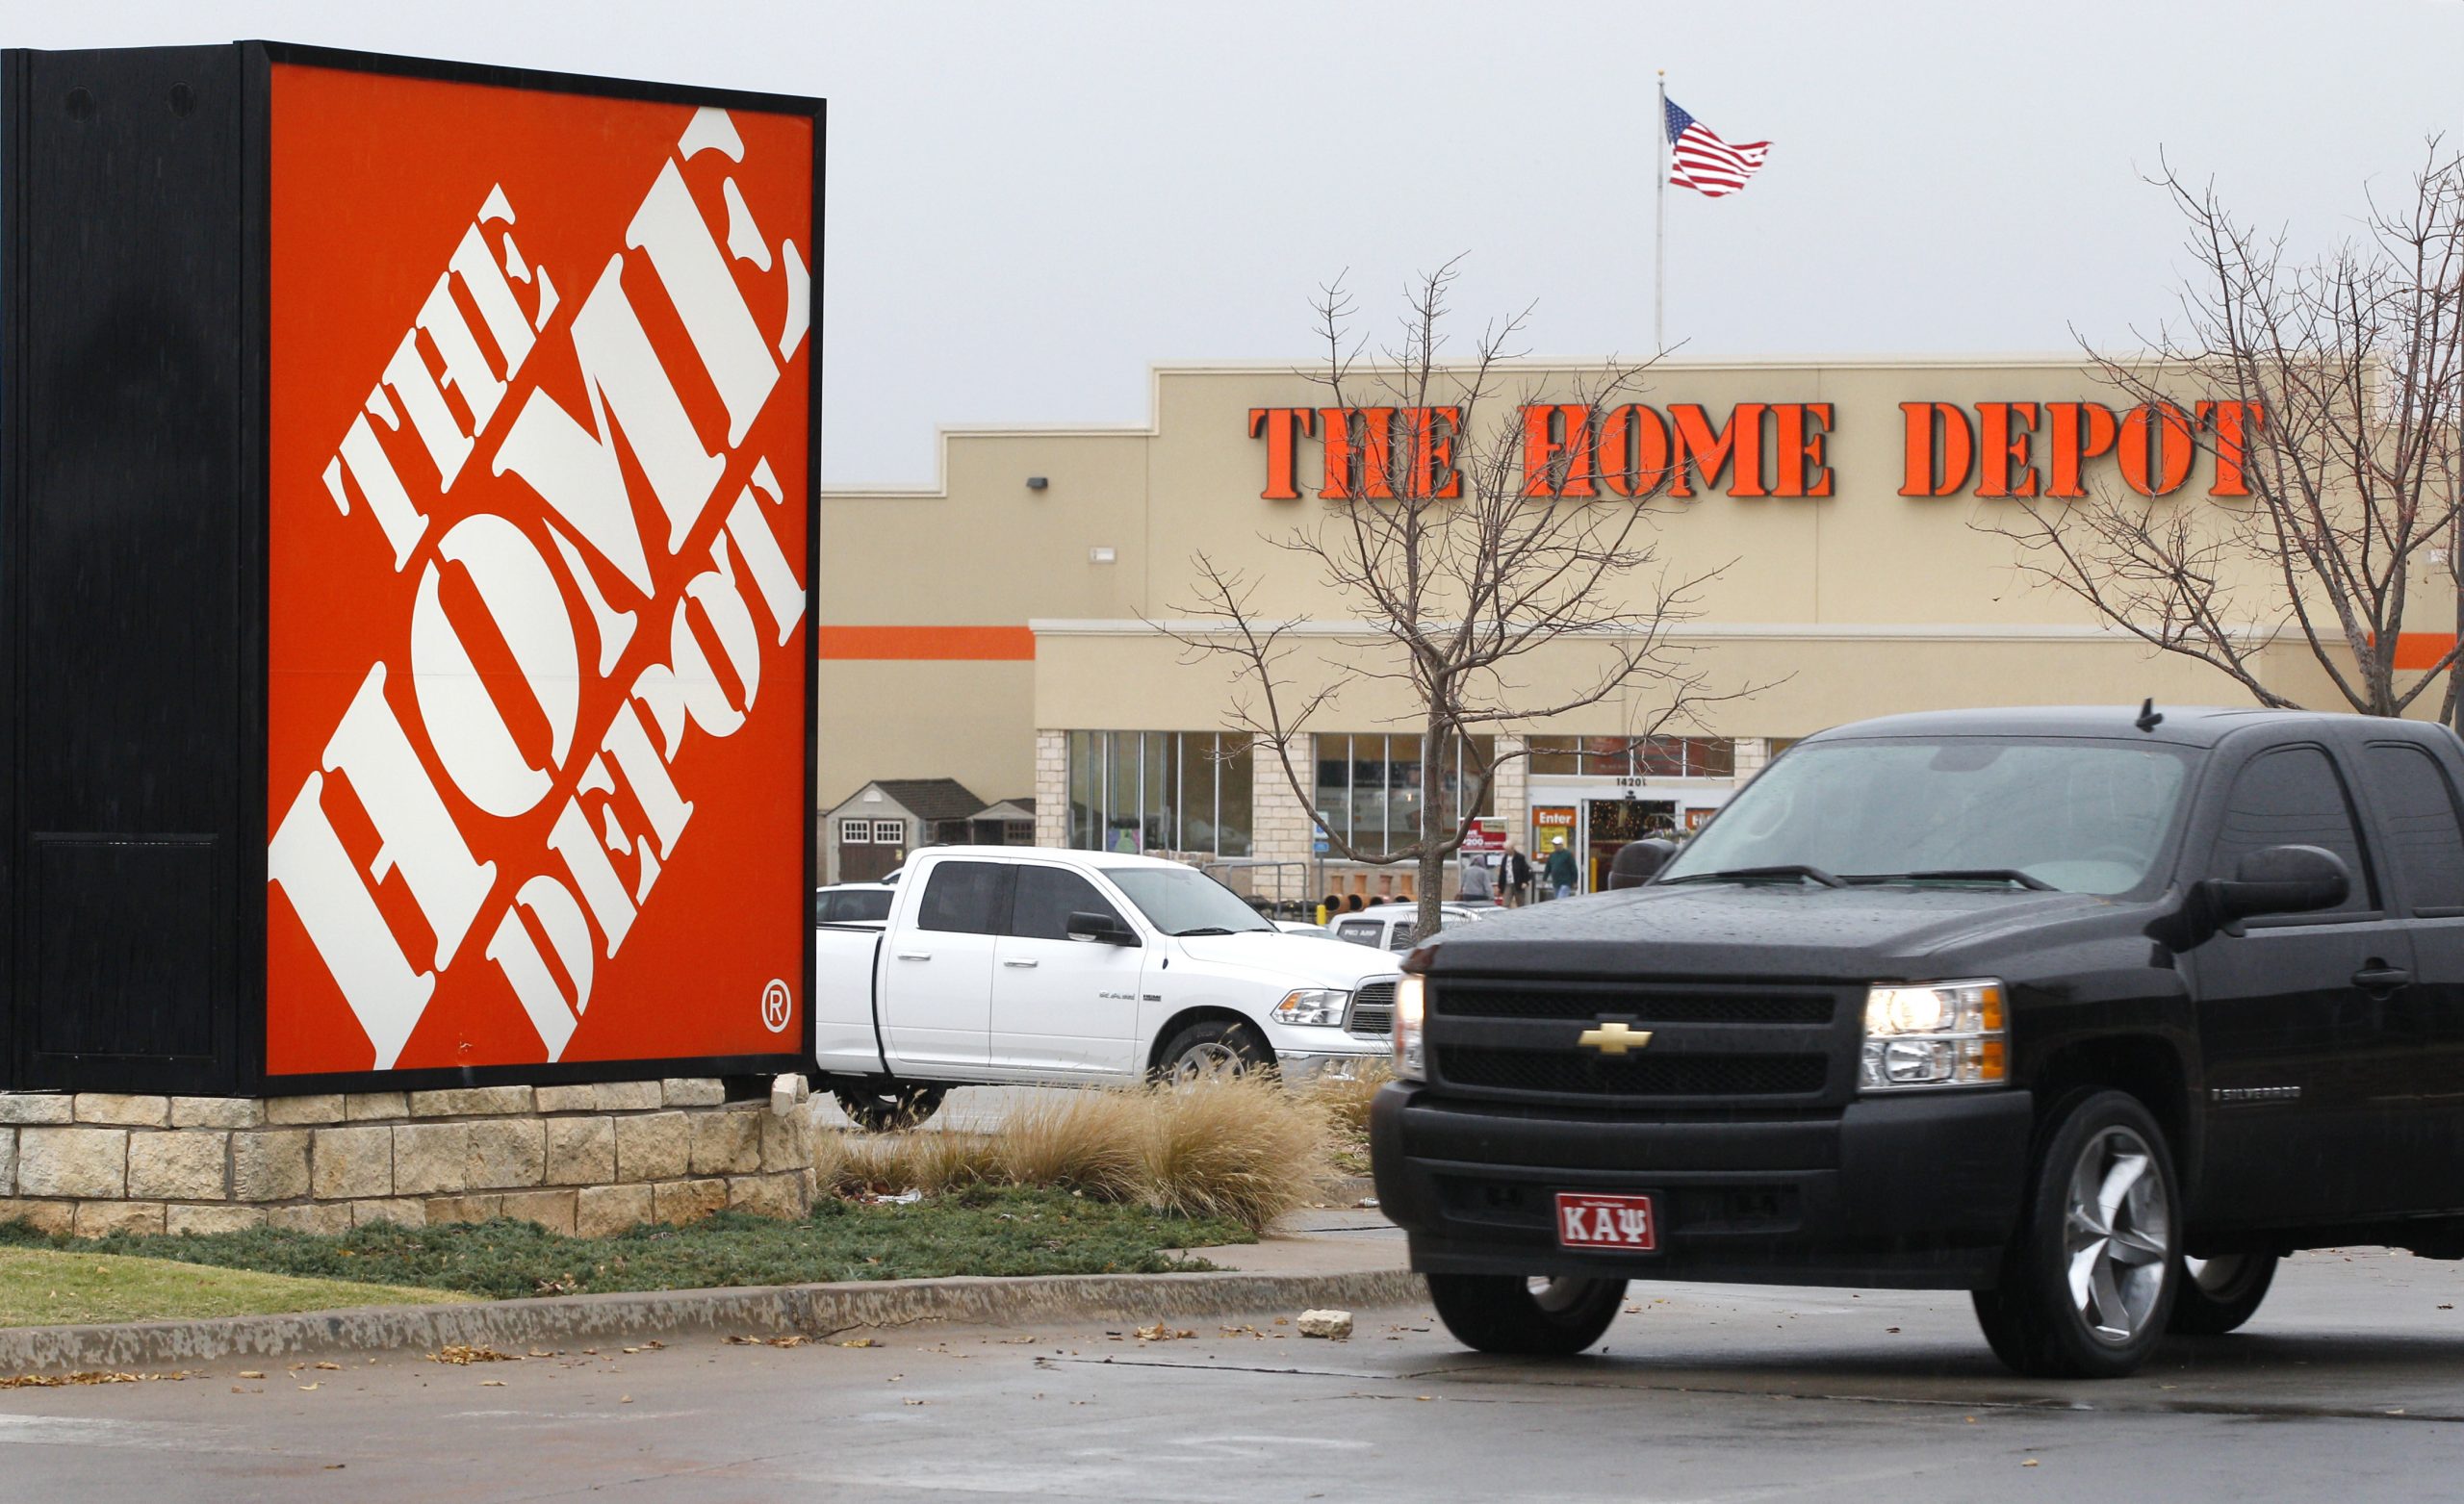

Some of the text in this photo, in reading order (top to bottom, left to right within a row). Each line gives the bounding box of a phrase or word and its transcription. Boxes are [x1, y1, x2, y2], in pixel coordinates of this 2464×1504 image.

[321, 183, 560, 573] THE
[1248, 401, 2265, 499] THE HOME DEPOT
[267, 107, 811, 1071] HOME
[485, 455, 807, 1063] DEPOT
[1539, 812, 1572, 825] Enter
